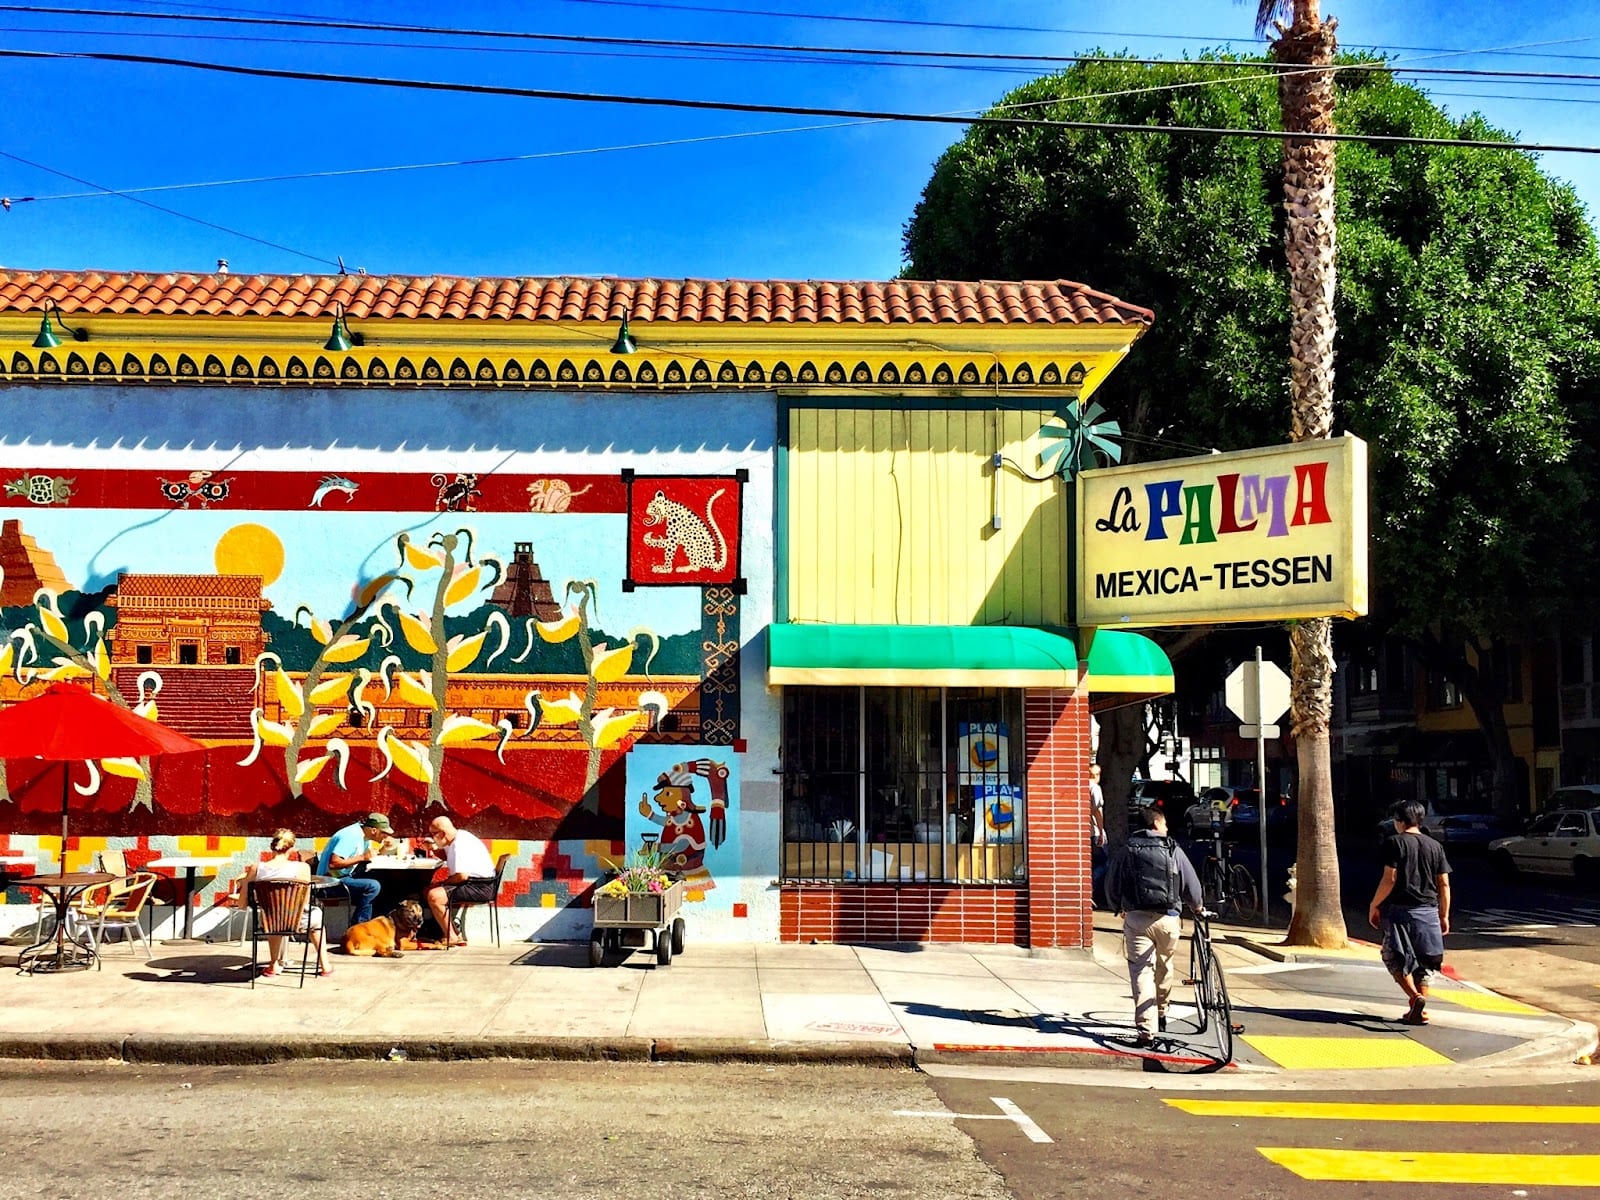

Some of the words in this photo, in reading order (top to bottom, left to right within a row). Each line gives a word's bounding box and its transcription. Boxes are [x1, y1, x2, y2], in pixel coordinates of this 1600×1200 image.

[1095, 486, 1141, 533] La
[1144, 461, 1332, 545] PALMA
[1096, 554, 1332, 598] MEXICA-TESSEN
[969, 723, 998, 733] PLAY
[984, 785, 1012, 795] PLAY
